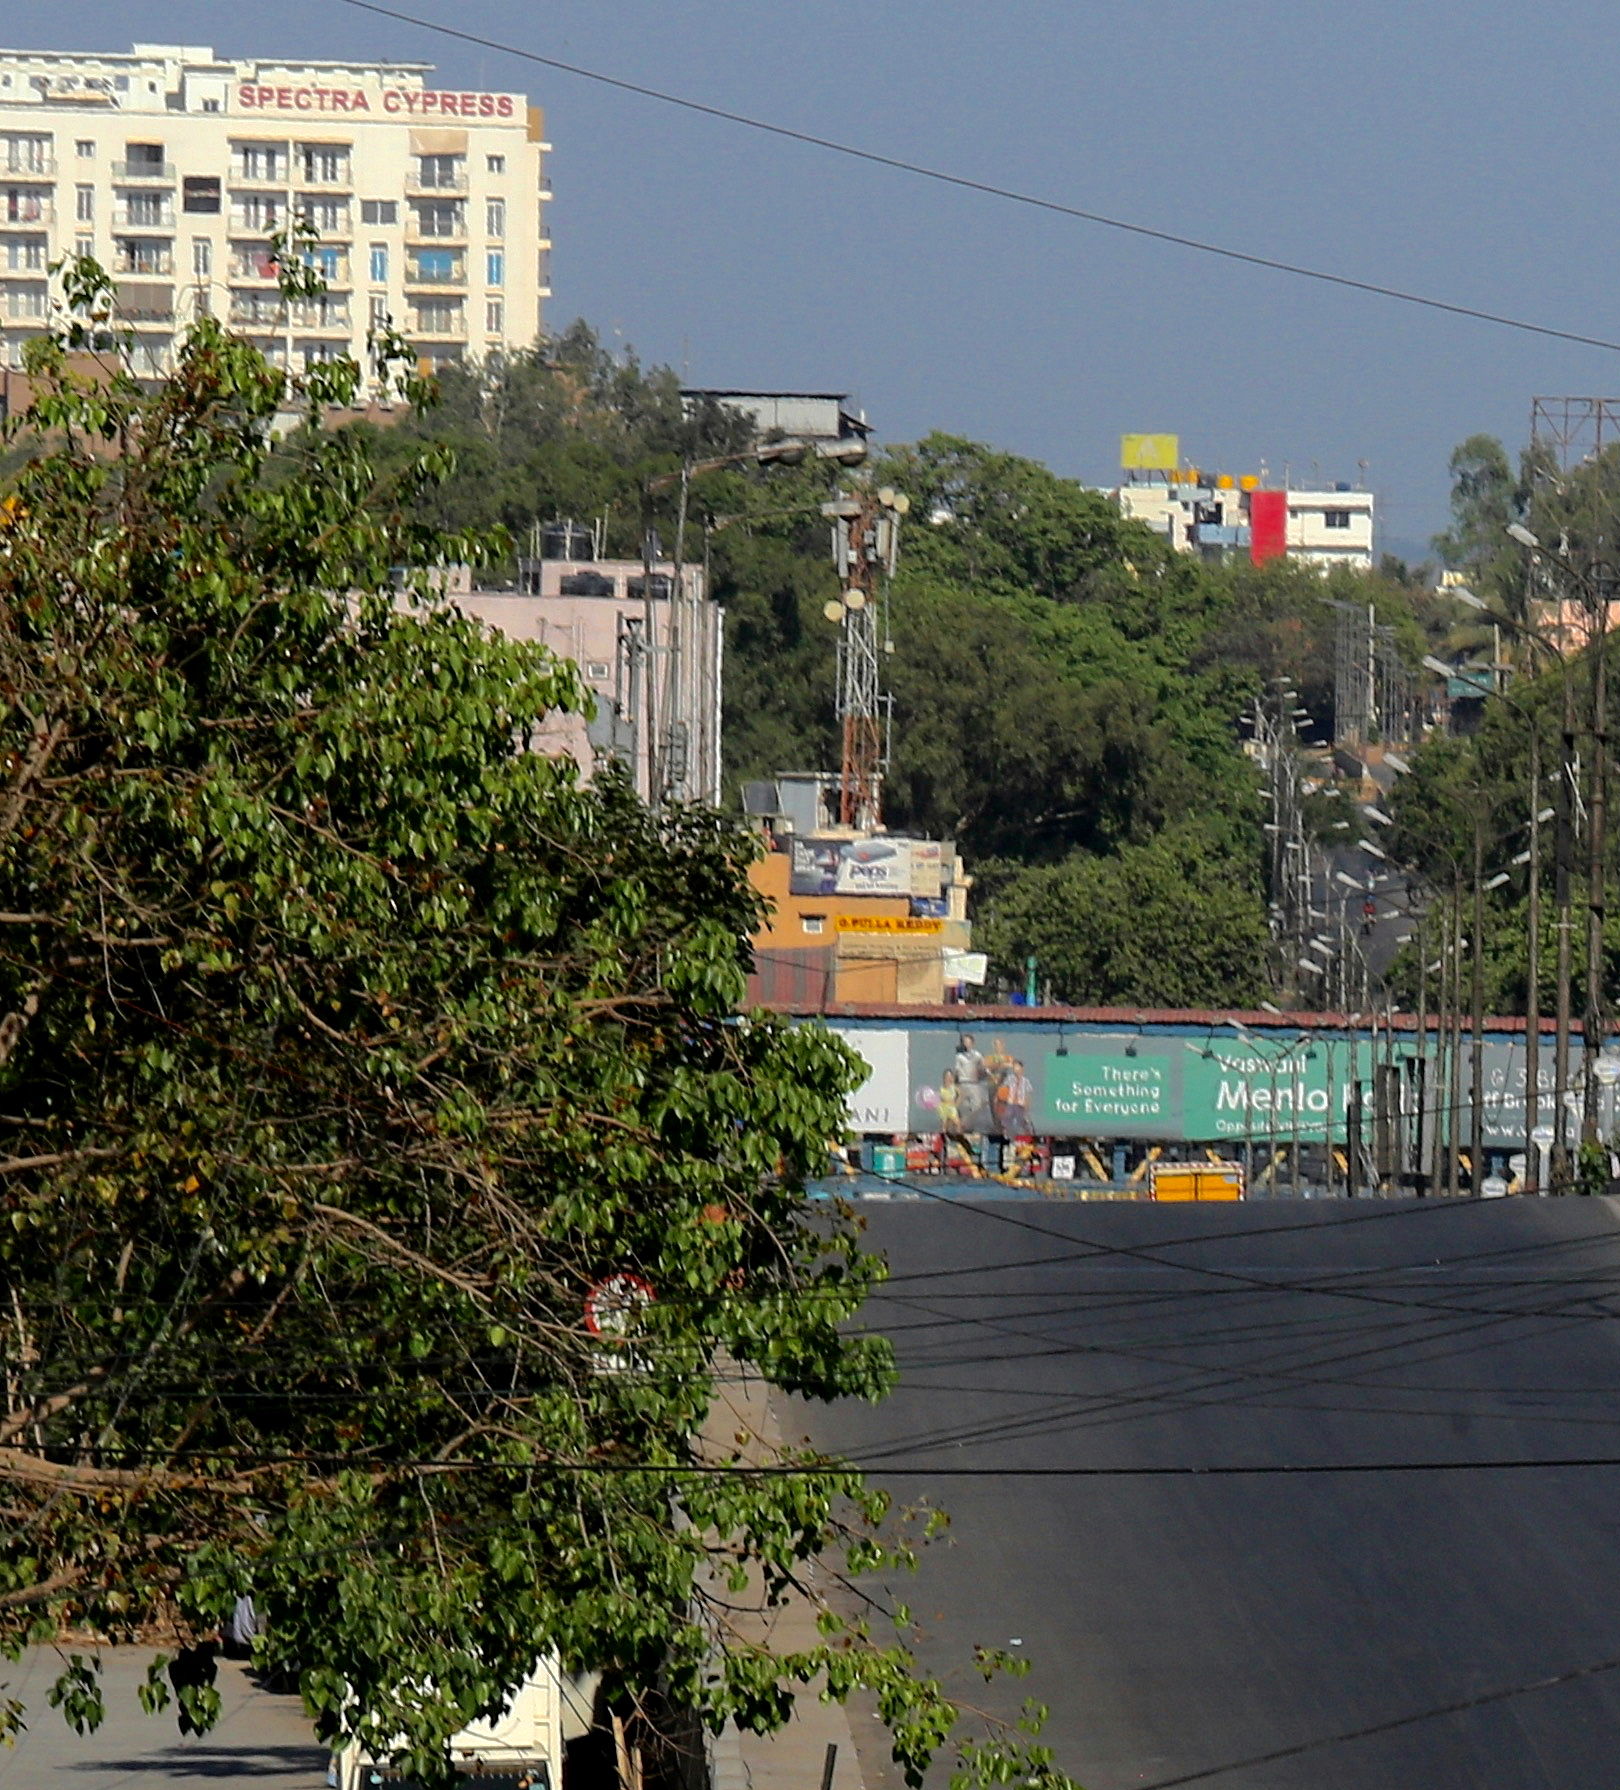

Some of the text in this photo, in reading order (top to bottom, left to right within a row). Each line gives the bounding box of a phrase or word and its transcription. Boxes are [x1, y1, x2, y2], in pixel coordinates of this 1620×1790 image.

[239, 86, 514, 118] SPECTRA CYPRESS
[1072, 1082, 1161, 1102] Something
[1217, 1081, 1330, 1111] Menlo
[1055, 1099, 1161, 1116] for Everyone
